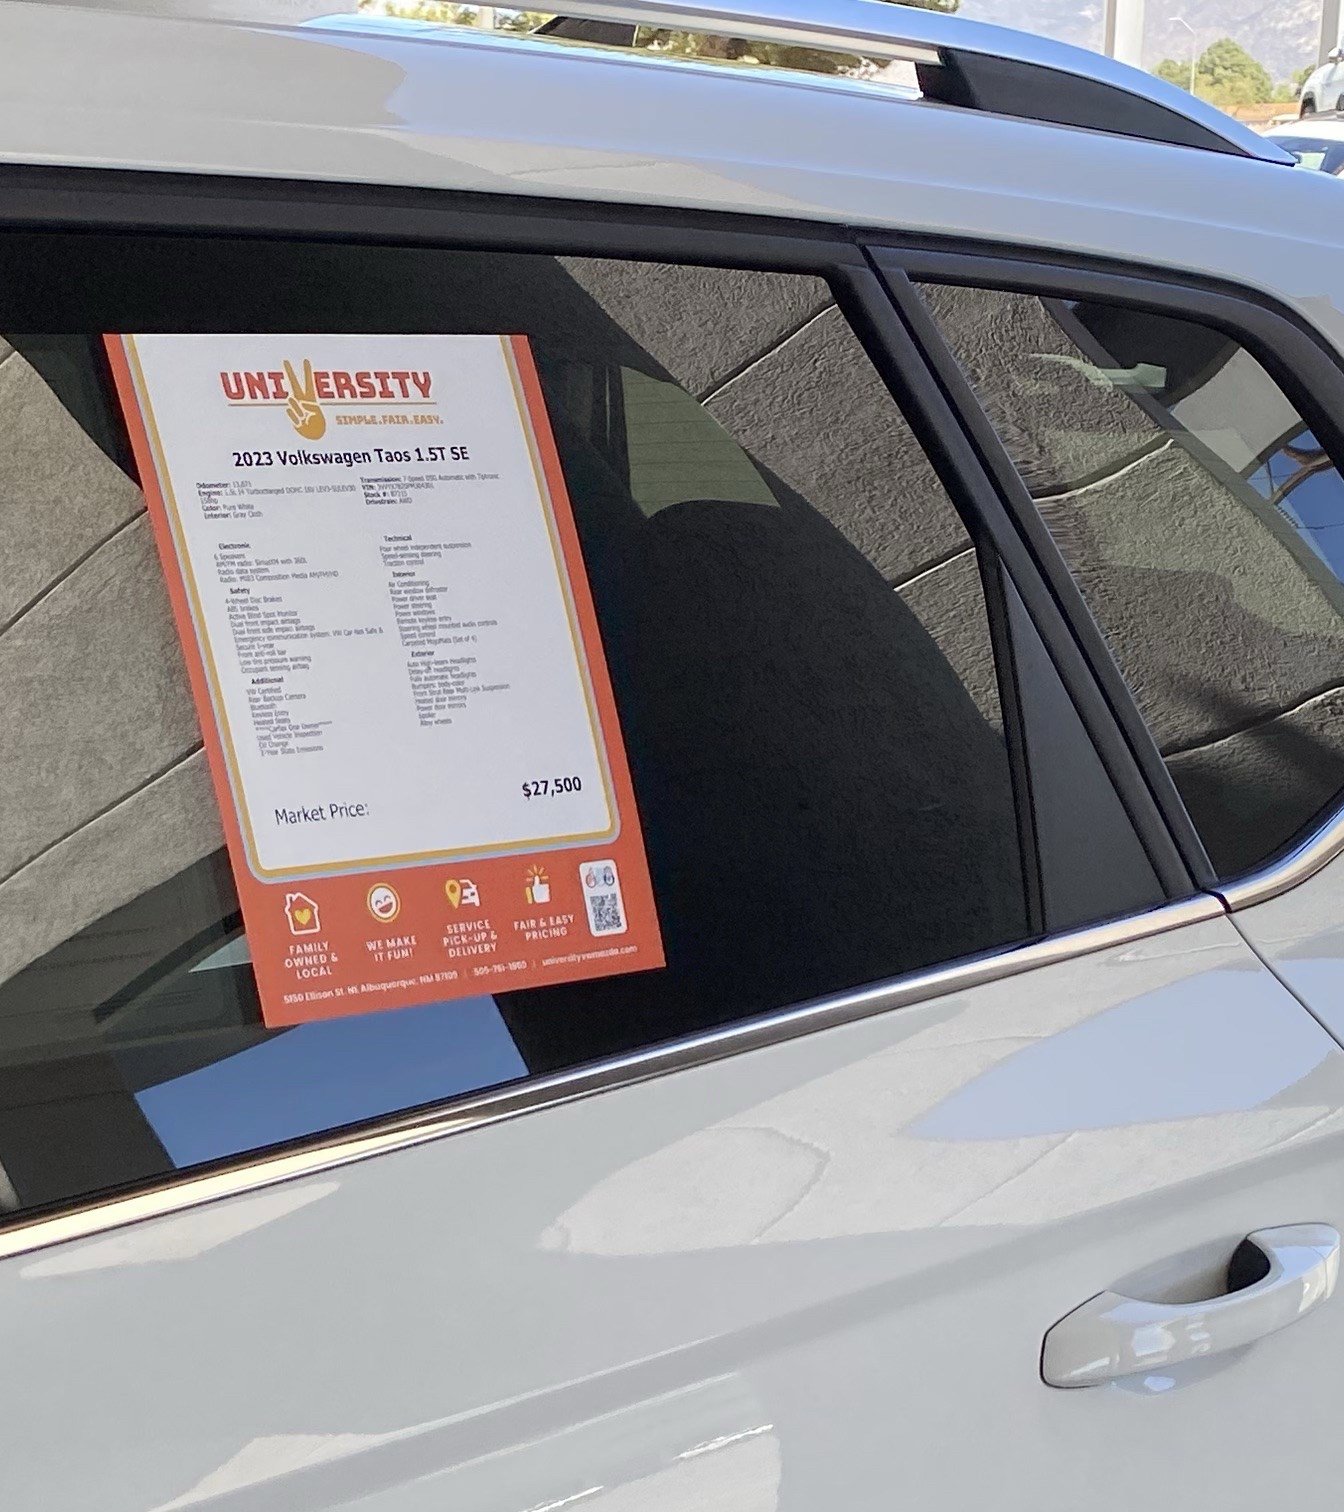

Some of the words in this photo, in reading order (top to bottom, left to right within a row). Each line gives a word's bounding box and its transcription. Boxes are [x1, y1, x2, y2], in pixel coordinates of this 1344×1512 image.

[220, 361, 432, 401] UNIVERSITY
[231, 450, 274, 468] 2023
[275, 448, 372, 467] Volkswagen
[373, 447, 412, 464] Taos
[414, 446, 448, 463] 1.5T
[448, 446, 470, 462] SE
[520, 775, 583, 800] $27,500
[272, 804, 326, 825] Market
[328, 799, 370, 819] Price:
[445, 919, 491, 934] SERVICE
[512, 919, 536, 930] FAIR
[538, 917, 547, 927] &
[548, 913, 575, 925] EASY
[441, 931, 488, 947] PICK-UP
[489, 930, 498, 940] &
[524, 926, 568, 941] PRICING
[287, 940, 330, 955] FAMILY
[365, 939, 384, 951] WE
[385, 935, 417, 948] MAKE
[447, 942, 498, 958] DELIVERY
[283, 953, 328, 969] OWNED
[330, 952, 339, 962] &
[373, 952, 385, 962] IT
[386, 948, 413, 960] FUN!
[295, 965, 332, 980] LOCAL
[303, 988, 334, 1001] Ellison
[419, 974, 435, 984] NM
